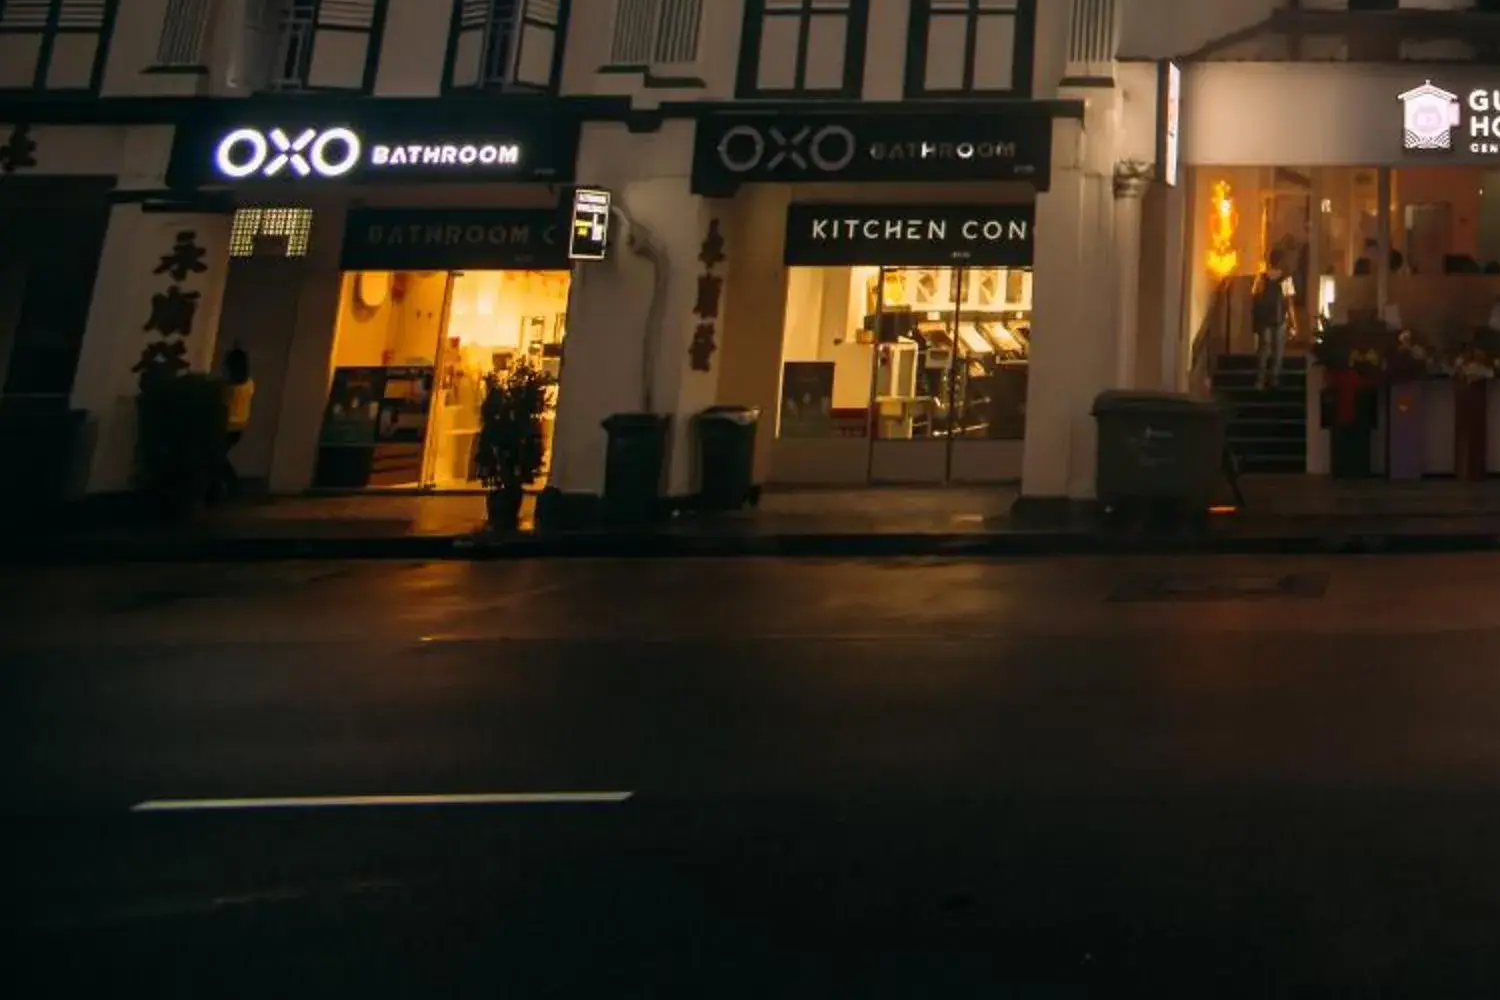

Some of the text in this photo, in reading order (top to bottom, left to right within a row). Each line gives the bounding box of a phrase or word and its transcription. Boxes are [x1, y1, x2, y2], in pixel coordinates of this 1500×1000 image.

[214, 126, 521, 178] OXO BATHROOM
[716, 125, 1016, 172] OXO BATHROOM
[368, 224, 531, 245] BATHROOM
[812, 219, 1035, 241] KITCHEN CON
